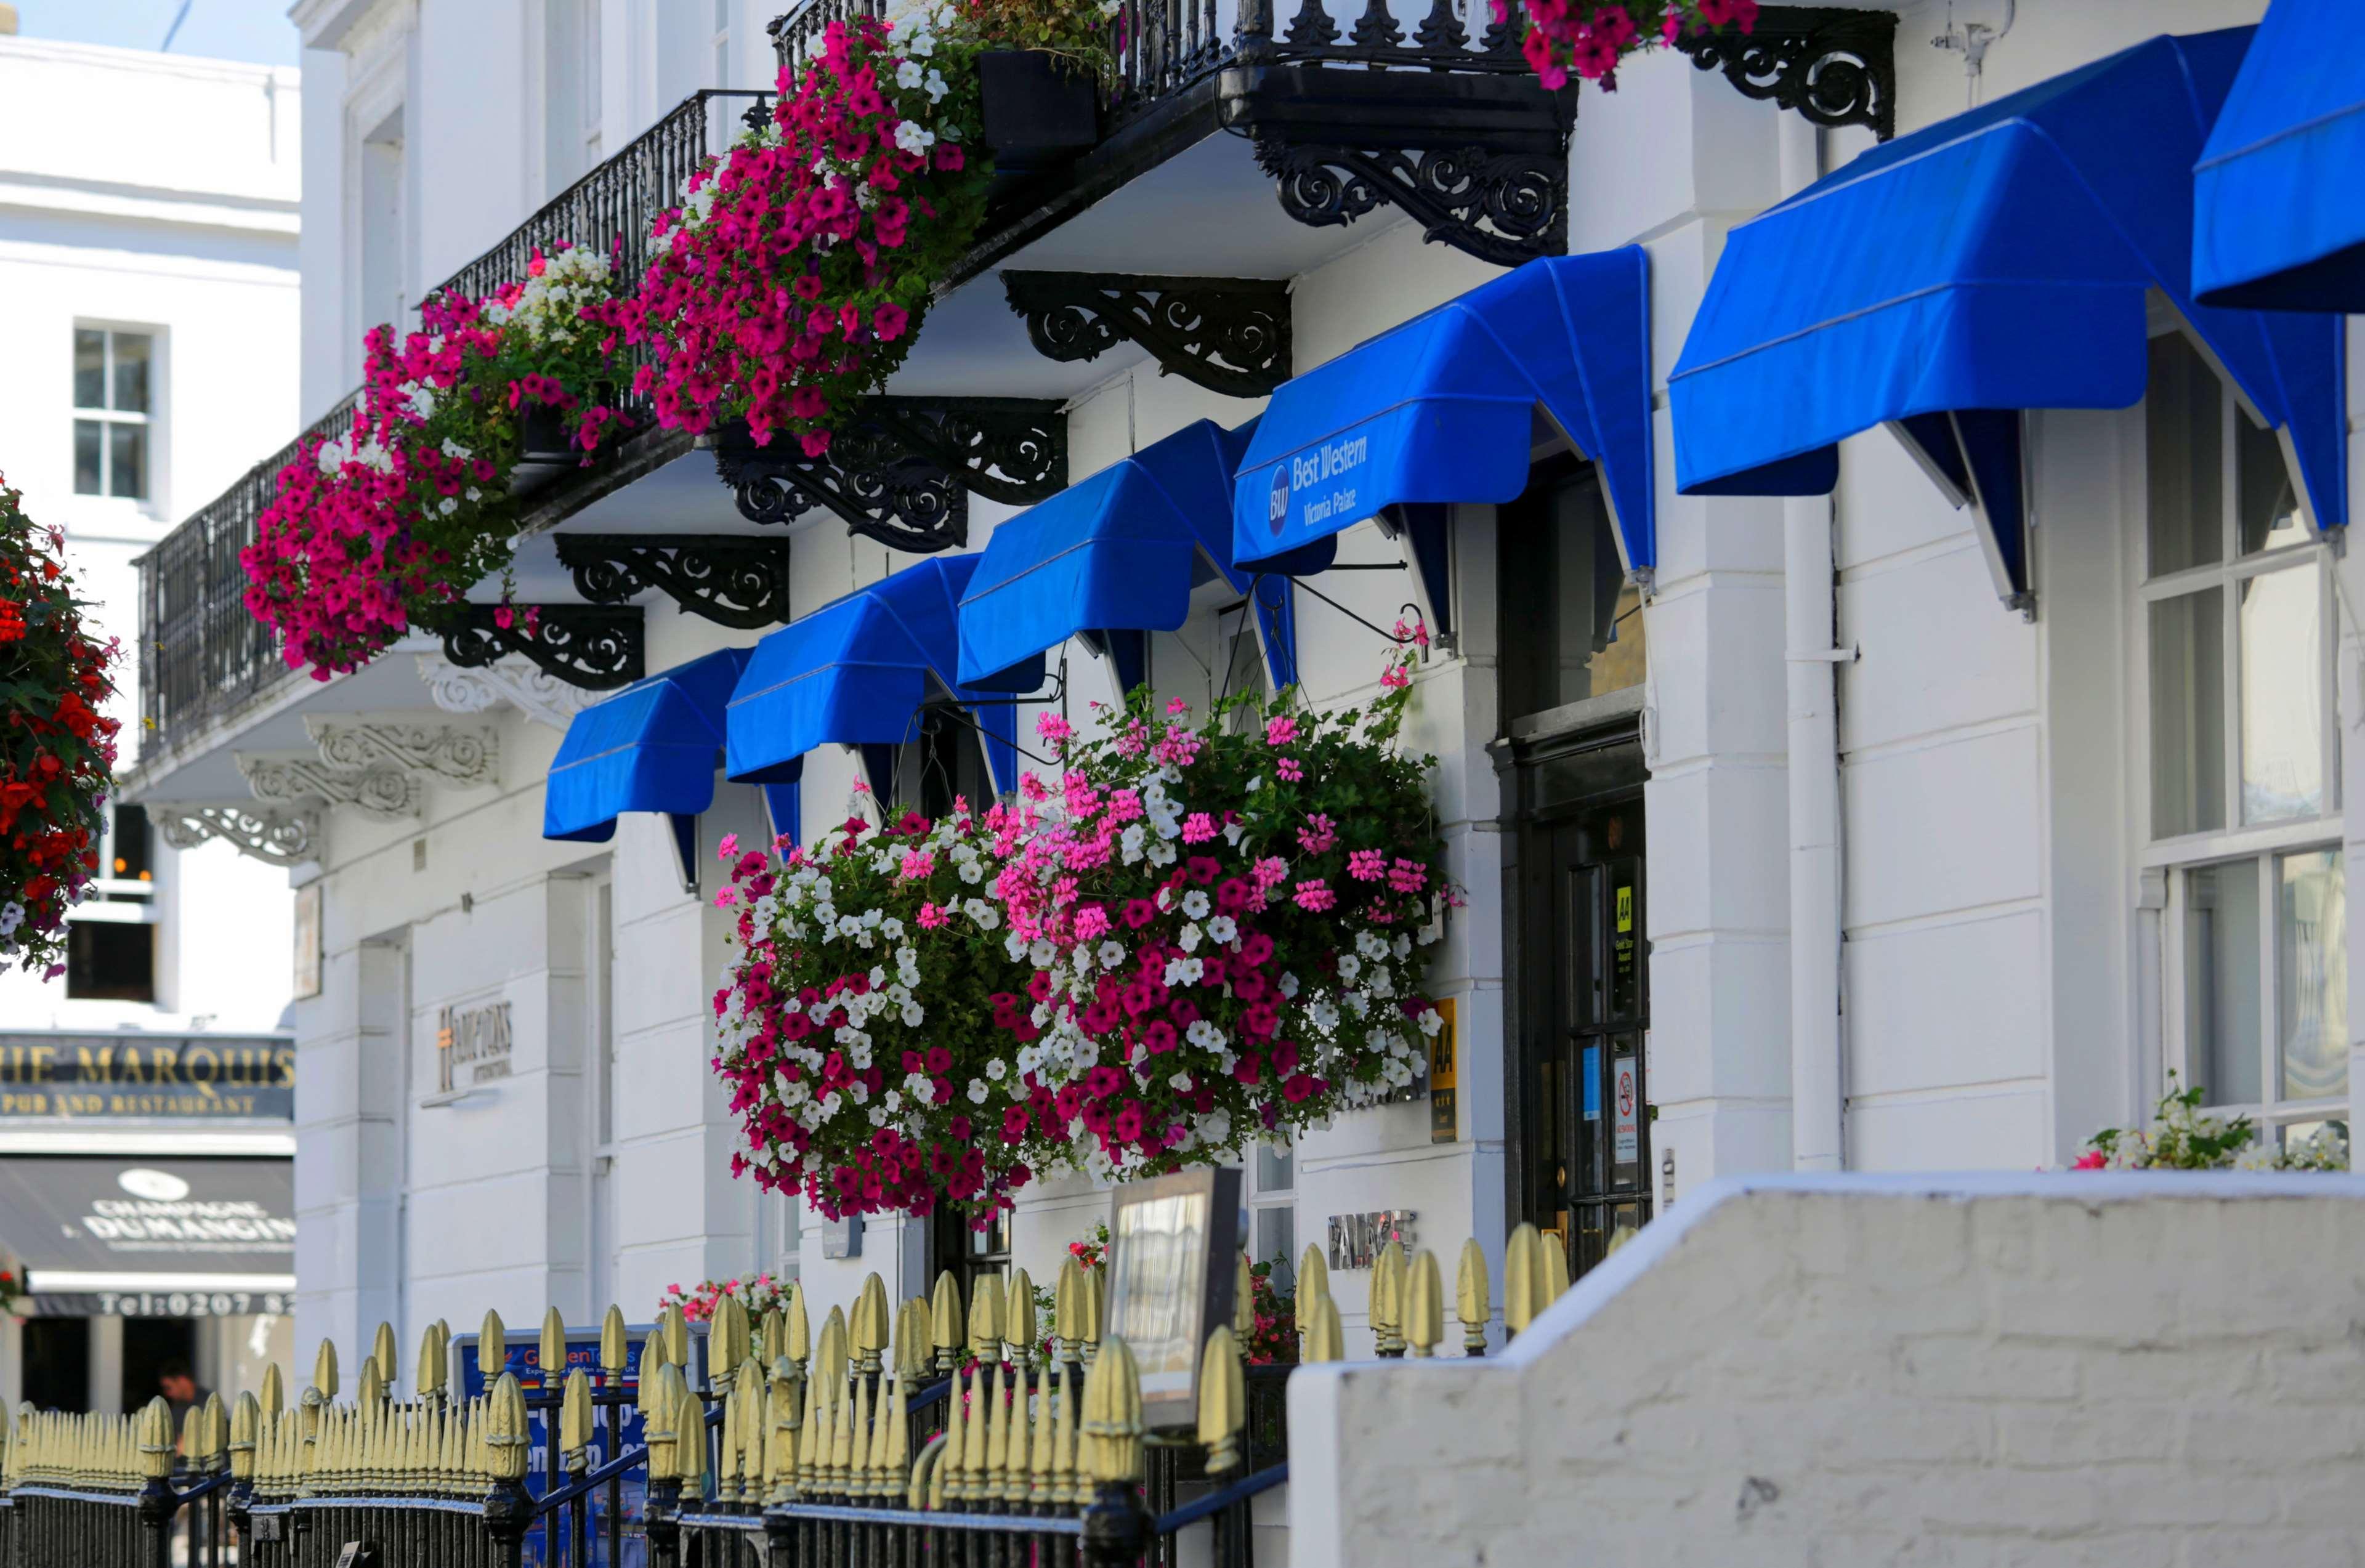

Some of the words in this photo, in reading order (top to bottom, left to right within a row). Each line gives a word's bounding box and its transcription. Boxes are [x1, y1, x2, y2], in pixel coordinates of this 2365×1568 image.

[1293, 452, 1320, 491] Best
[1320, 435, 1367, 481] Western
[1270, 486, 1288, 521] BW
[1304, 495, 1331, 527] Victoria
[1333, 488, 1356, 515] Palace
[1619, 896, 1630, 921] AA
[1434, 1024, 1453, 1074] AA
[77, 1046, 296, 1098] MARQUIS
[1, 1094, 47, 1113] PUB
[55, 1093, 103, 1113] AND
[111, 1094, 256, 1115] RESTAURANT
